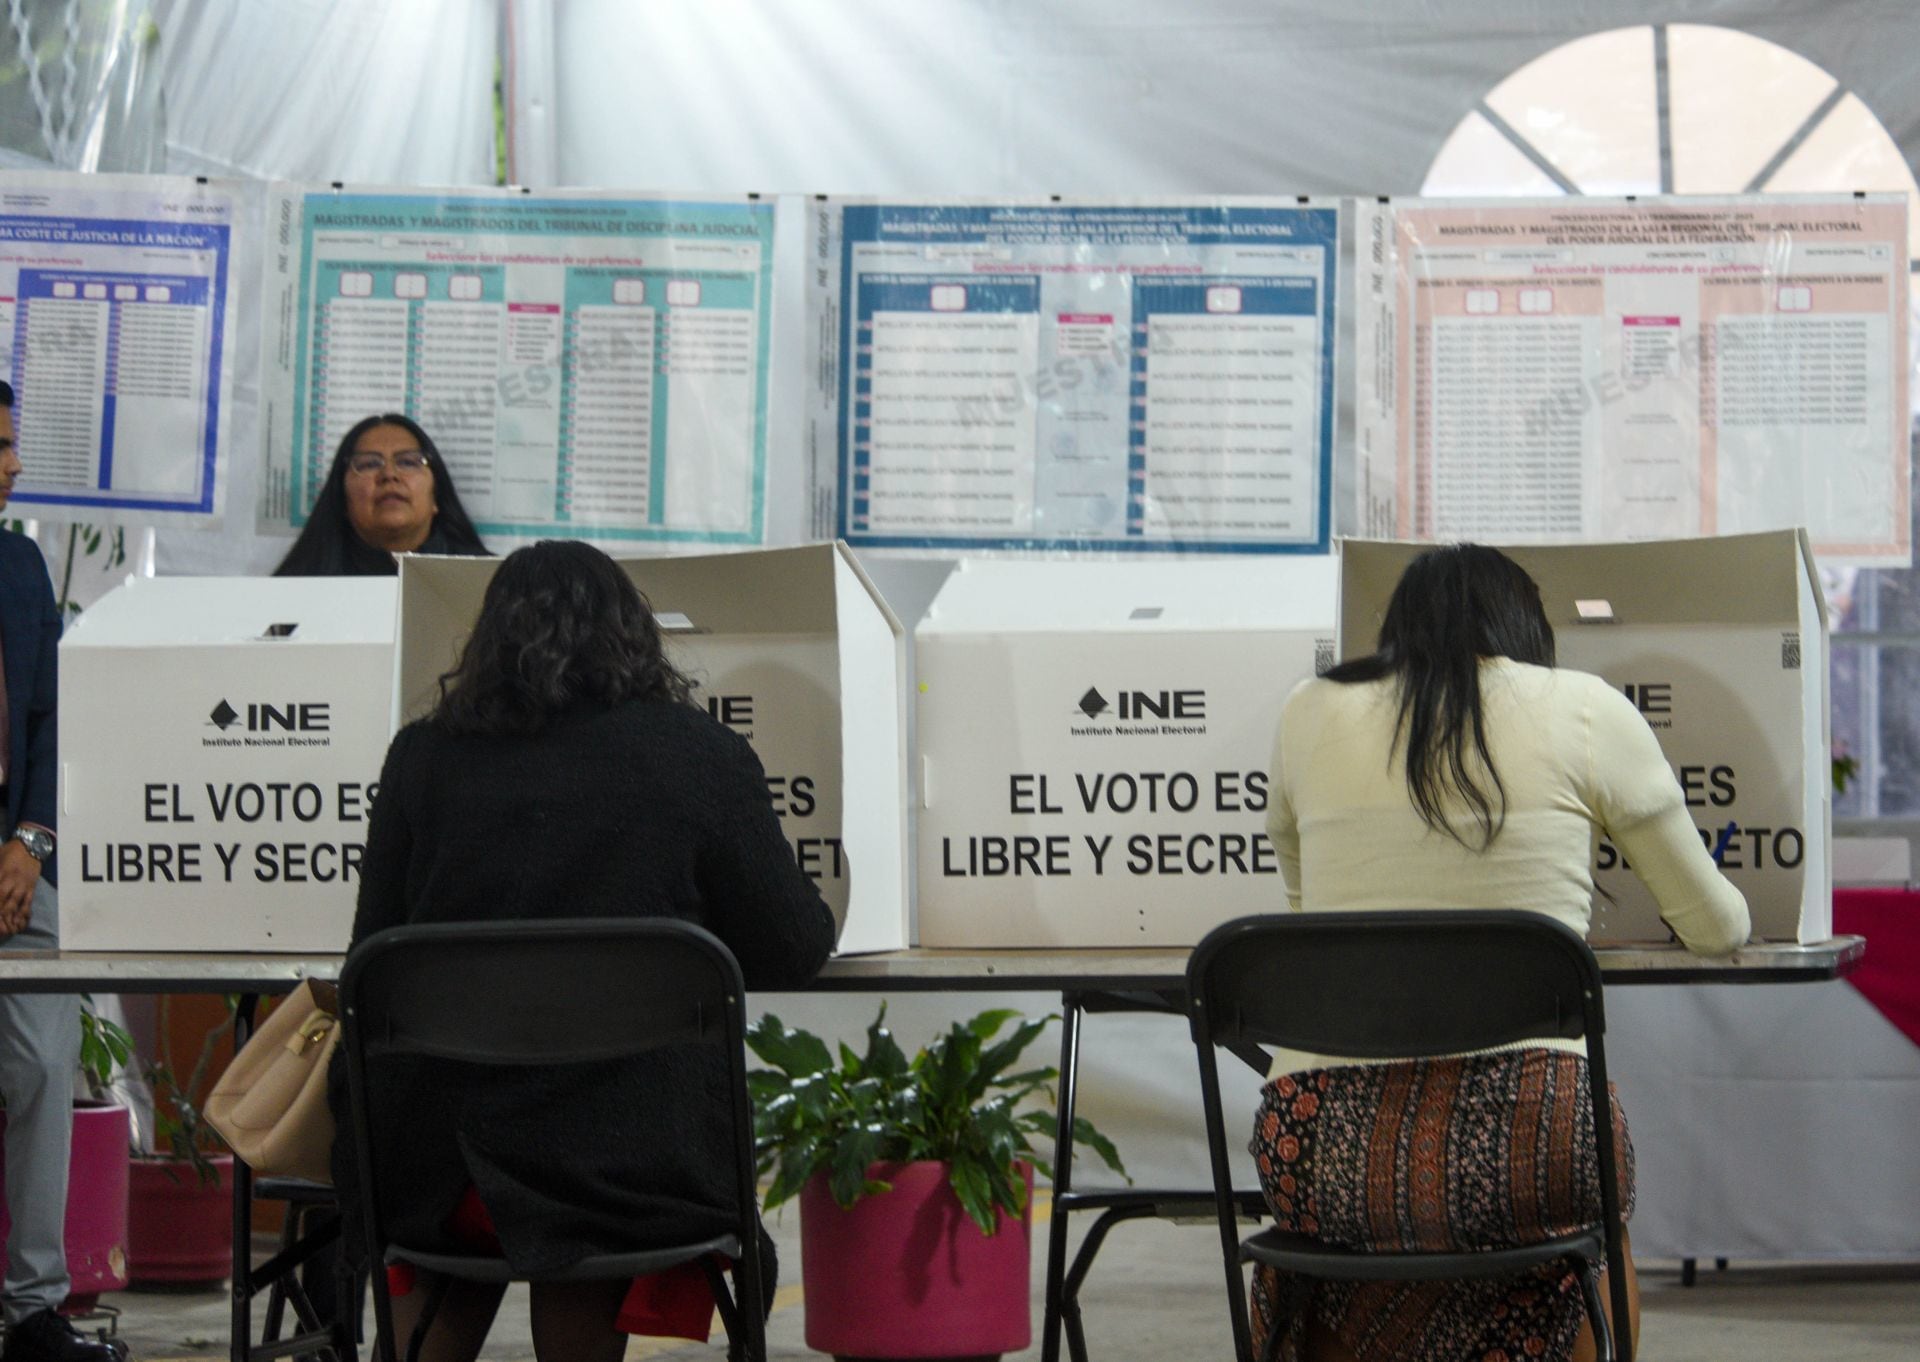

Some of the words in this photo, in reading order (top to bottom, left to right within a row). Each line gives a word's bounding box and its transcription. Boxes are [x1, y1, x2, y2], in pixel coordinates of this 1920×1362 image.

[15, 228, 50, 240] CORTE
[53, 230, 67, 241] DE
[71, 230, 119, 243] JUSTICIA
[122, 232, 135, 243] DE
[138, 233, 152, 243] LA
[314, 214, 404, 227] MAGISTRADAS
[410, 215, 418, 227] Y
[421, 216, 514, 230] MAGISTRADOS
[518, 219, 540, 231] DEL
[544, 219, 605, 232] TRIBUNAL
[608, 220, 622, 232] DE
[626, 221, 697, 233] DISCIPLINA
[702, 223, 760, 236] JUDICIAL
[1711, 263, 1768, 277] preferenc
[247, 702, 331, 732] INE
[1118, 690, 1206, 720] INE
[202, 736, 242, 747] Instituto
[244, 736, 285, 747] Nacional
[287, 736, 330, 747] Electoral
[1070, 725, 1112, 736] Instituto
[1115, 725, 1159, 735] Nacional
[1162, 724, 1207, 735] Electoral
[1009, 773, 1063, 815] EL
[1075, 772, 1199, 814] VOTO
[1214, 770, 1269, 812] ES
[1680, 765, 1736, 807] ES
[144, 783, 195, 823] EL
[205, 782, 323, 823] VOTO
[81, 843, 202, 883] LIBRE
[214, 843, 241, 883] Y
[254, 842, 367, 883] SECR
[942, 835, 1072, 877] LIBRE
[1084, 835, 1114, 876] Y
[1126, 833, 1278, 876] SECRE
